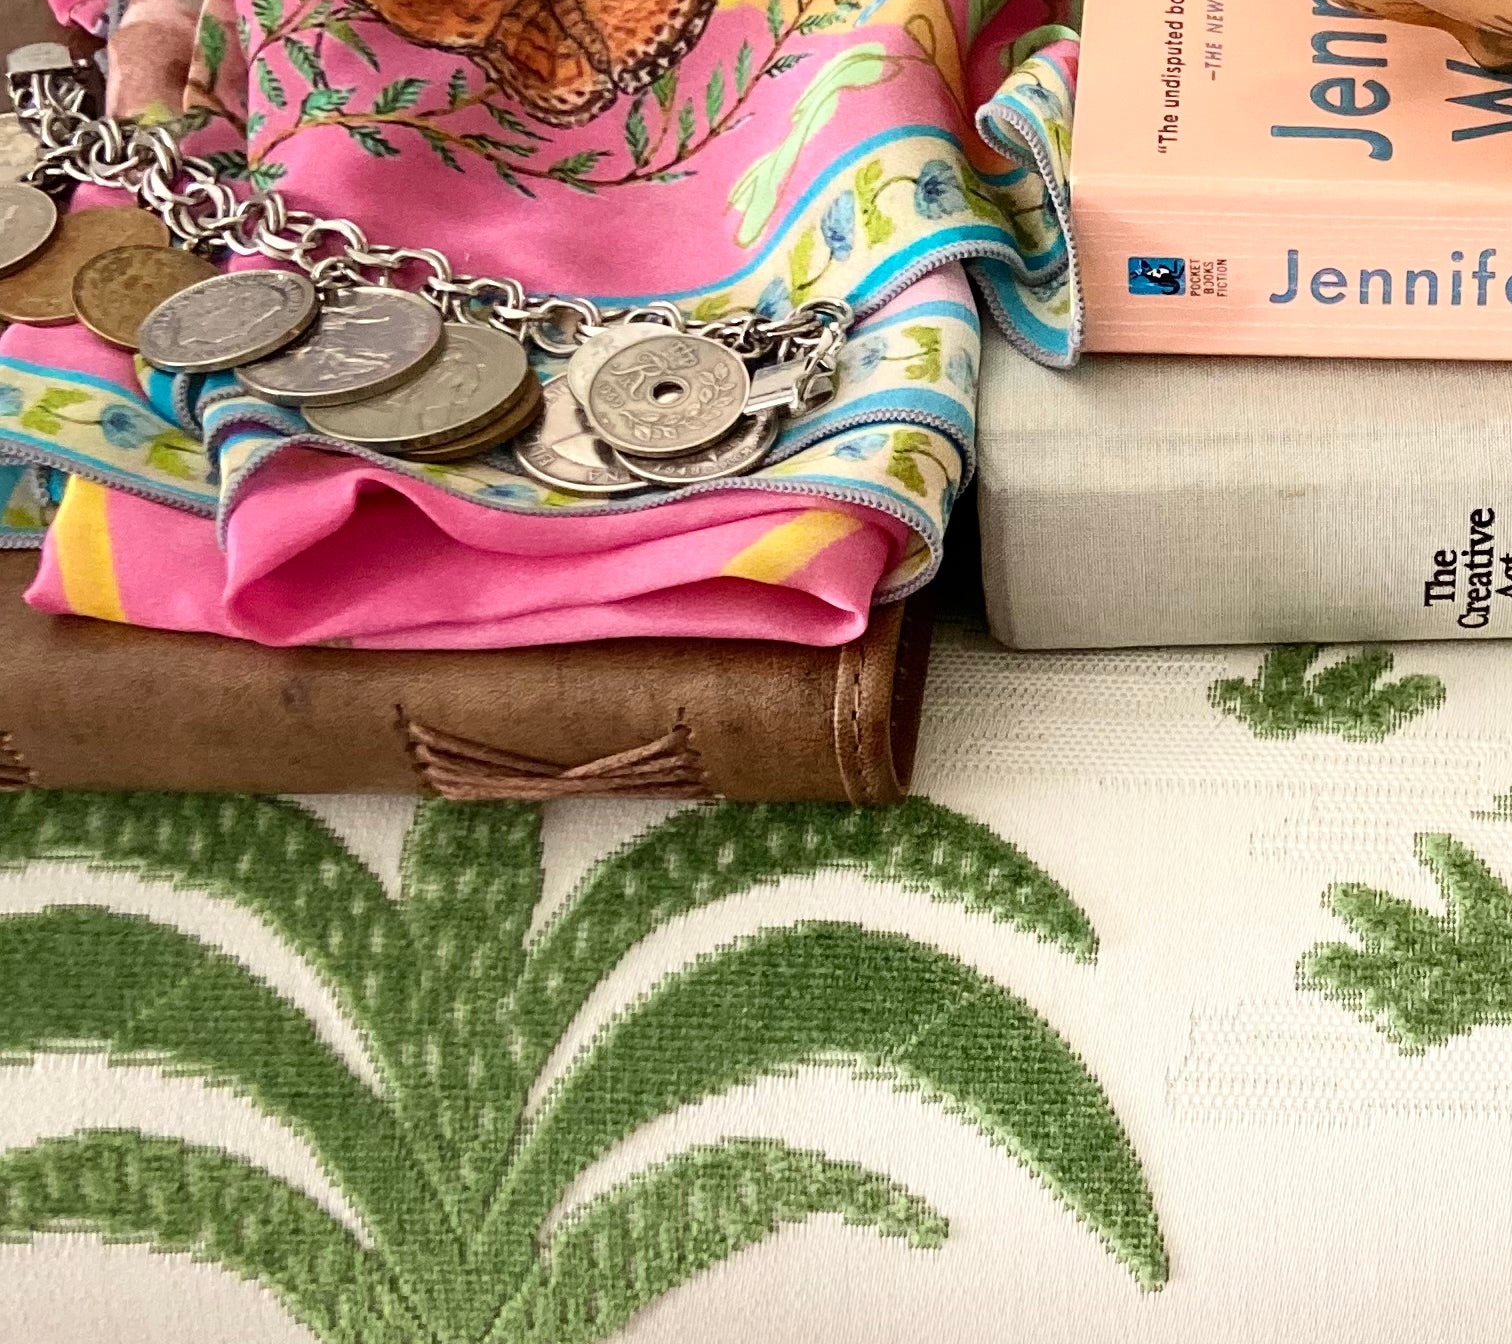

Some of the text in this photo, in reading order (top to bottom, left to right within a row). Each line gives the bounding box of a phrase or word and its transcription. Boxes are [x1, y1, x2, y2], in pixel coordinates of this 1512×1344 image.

[1206, 0, 1225, 34] NEW
[1161, 20, 1187, 108] undisputed
[1189, 258, 1202, 297] POCKET
[1203, 261, 1215, 295] BOOKS
[1216, 258, 1229, 298] FICTION
[1423, 548, 1458, 607] The
[1456, 506, 1496, 629] Creative
